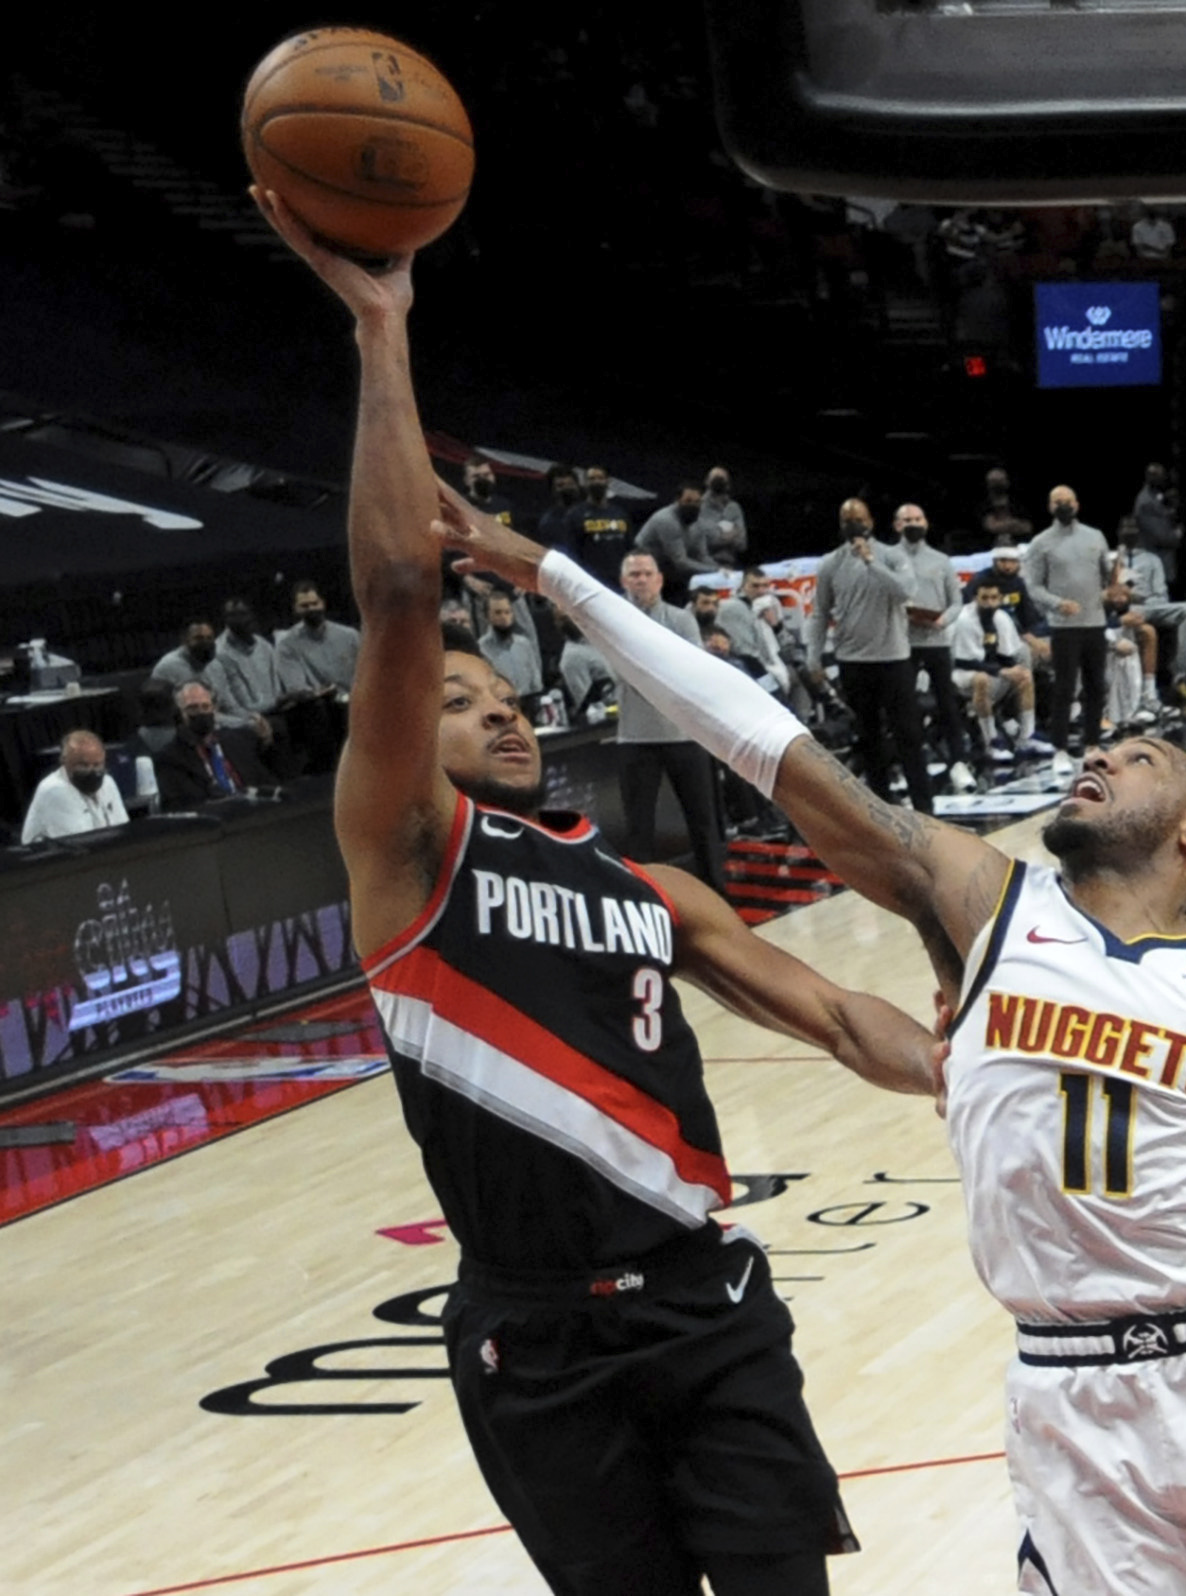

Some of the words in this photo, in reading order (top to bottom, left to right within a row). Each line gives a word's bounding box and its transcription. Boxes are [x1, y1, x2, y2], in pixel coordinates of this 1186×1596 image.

[1044, 326, 1152, 350] Windermere
[471, 868, 673, 966] PORTLAND
[633, 969, 663, 1052] 3
[1059, 1072, 1138, 1197] 11
